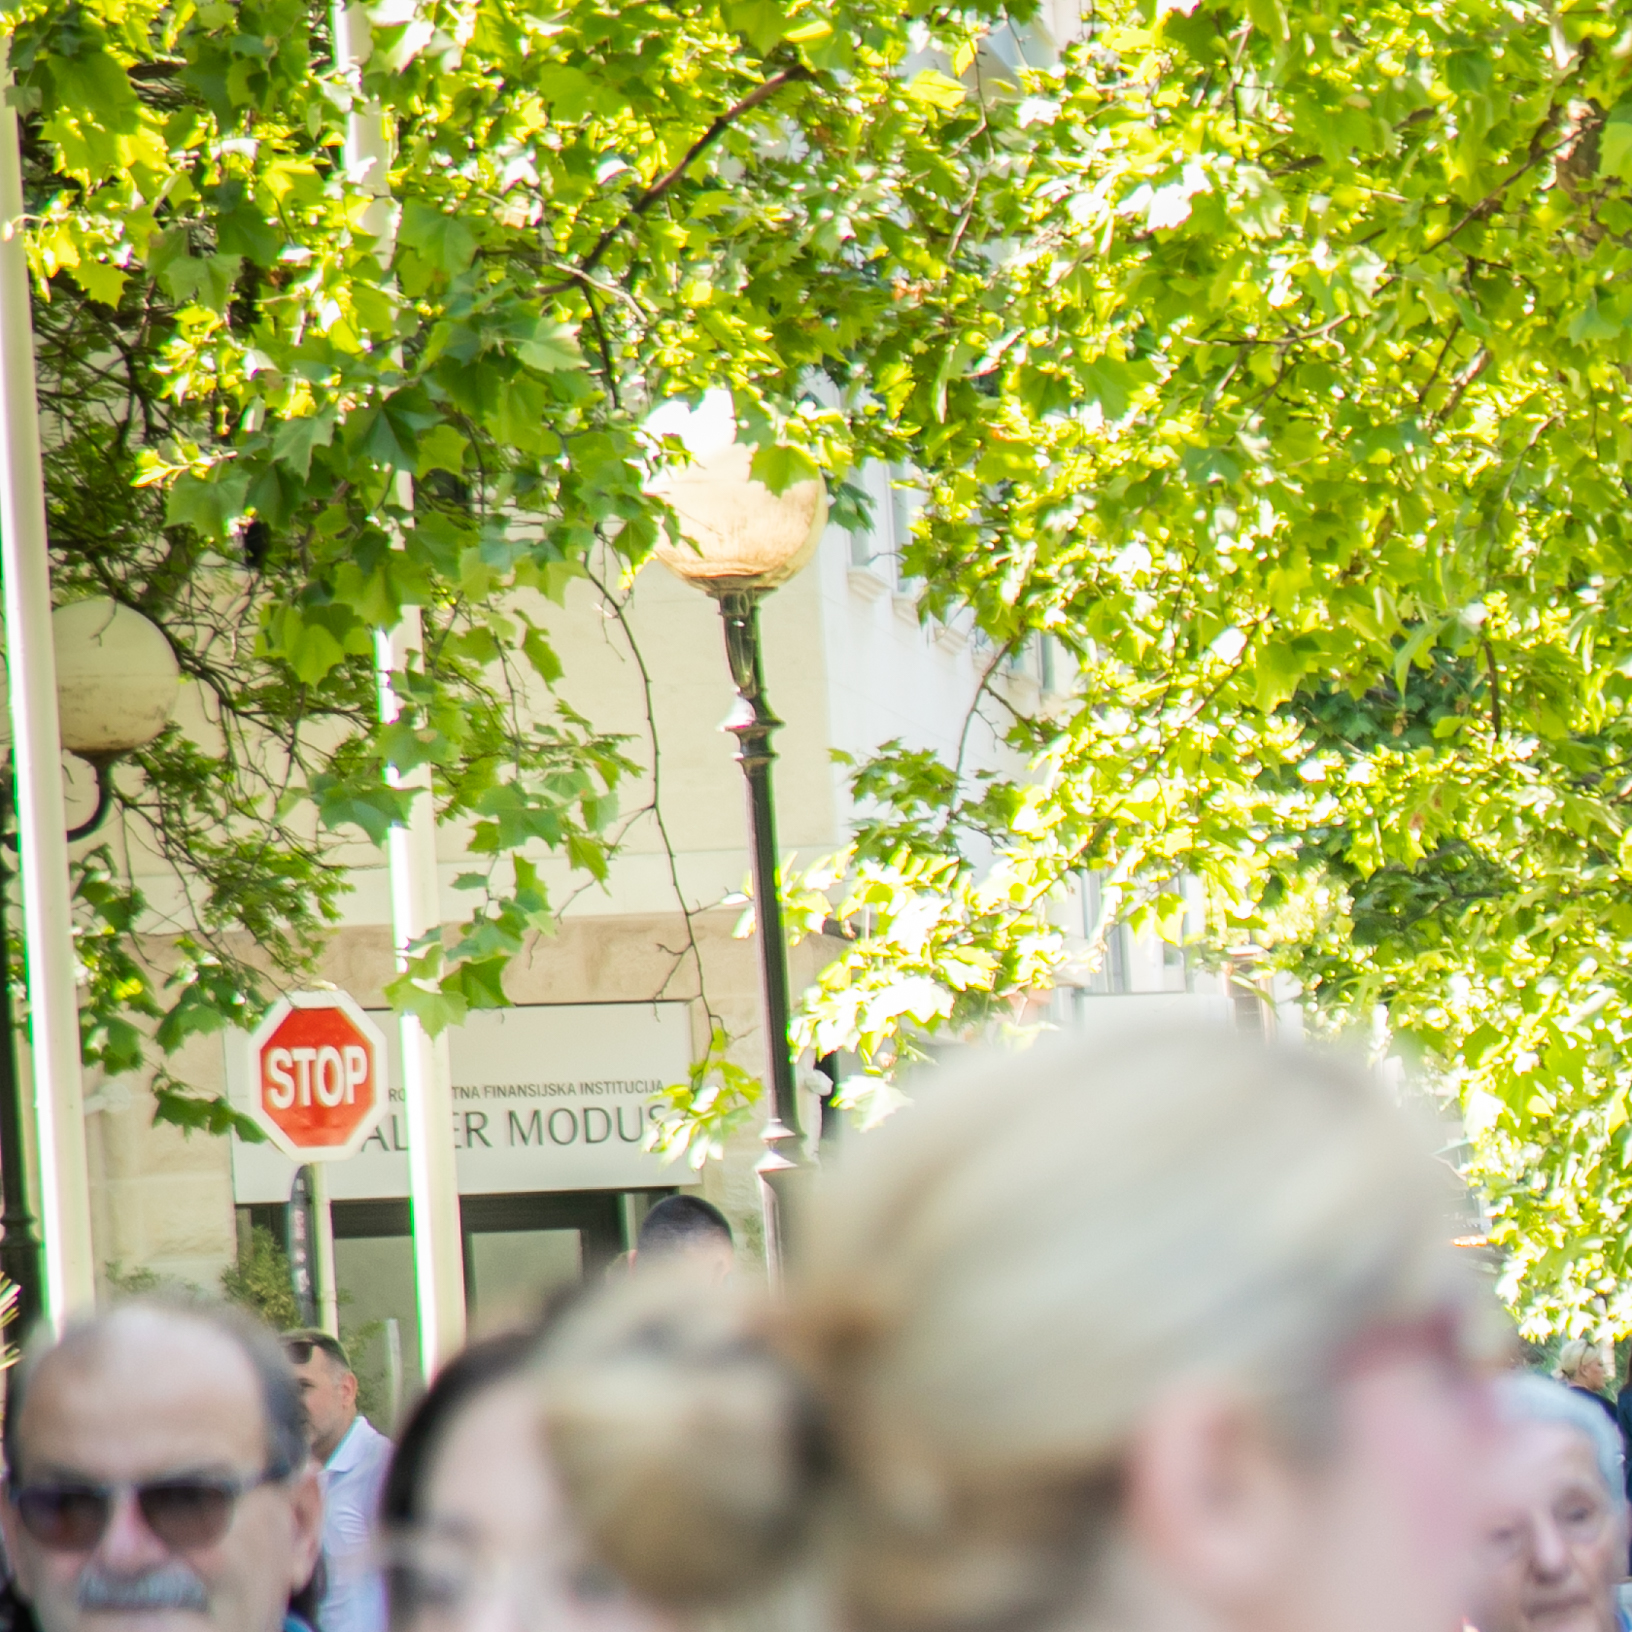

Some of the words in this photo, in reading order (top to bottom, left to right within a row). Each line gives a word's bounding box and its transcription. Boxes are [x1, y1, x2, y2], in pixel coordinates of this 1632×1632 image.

[269, 1045, 368, 1109] STOP
[484, 1083, 577, 1099] FINANSIJSKA
[580, 1079, 664, 1096] INSTITUCIJA
[361, 1110, 493, 1152] ALR
